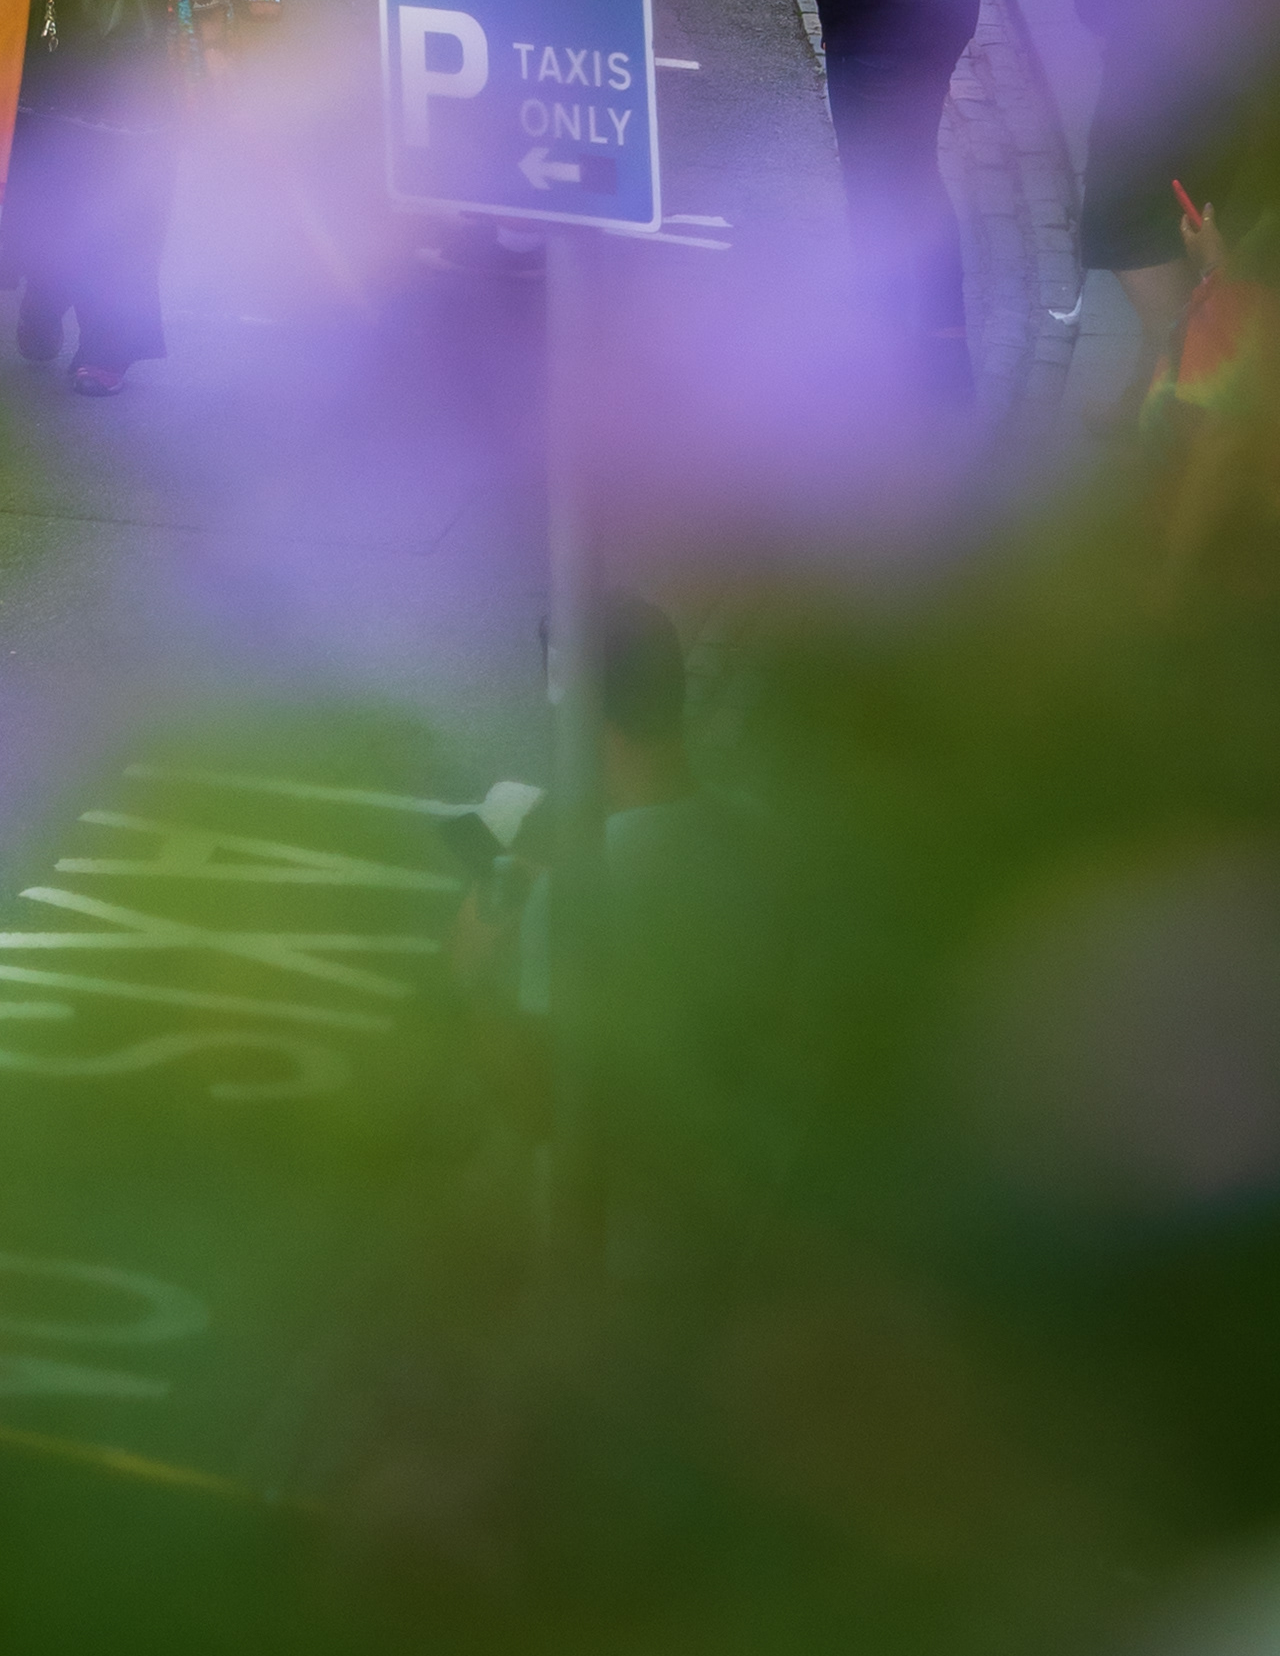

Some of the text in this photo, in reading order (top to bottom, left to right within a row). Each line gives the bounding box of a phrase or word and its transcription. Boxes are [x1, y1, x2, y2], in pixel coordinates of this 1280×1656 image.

[398, 5, 633, 149] P TAXIS
[520, 97, 633, 147] ONLY
